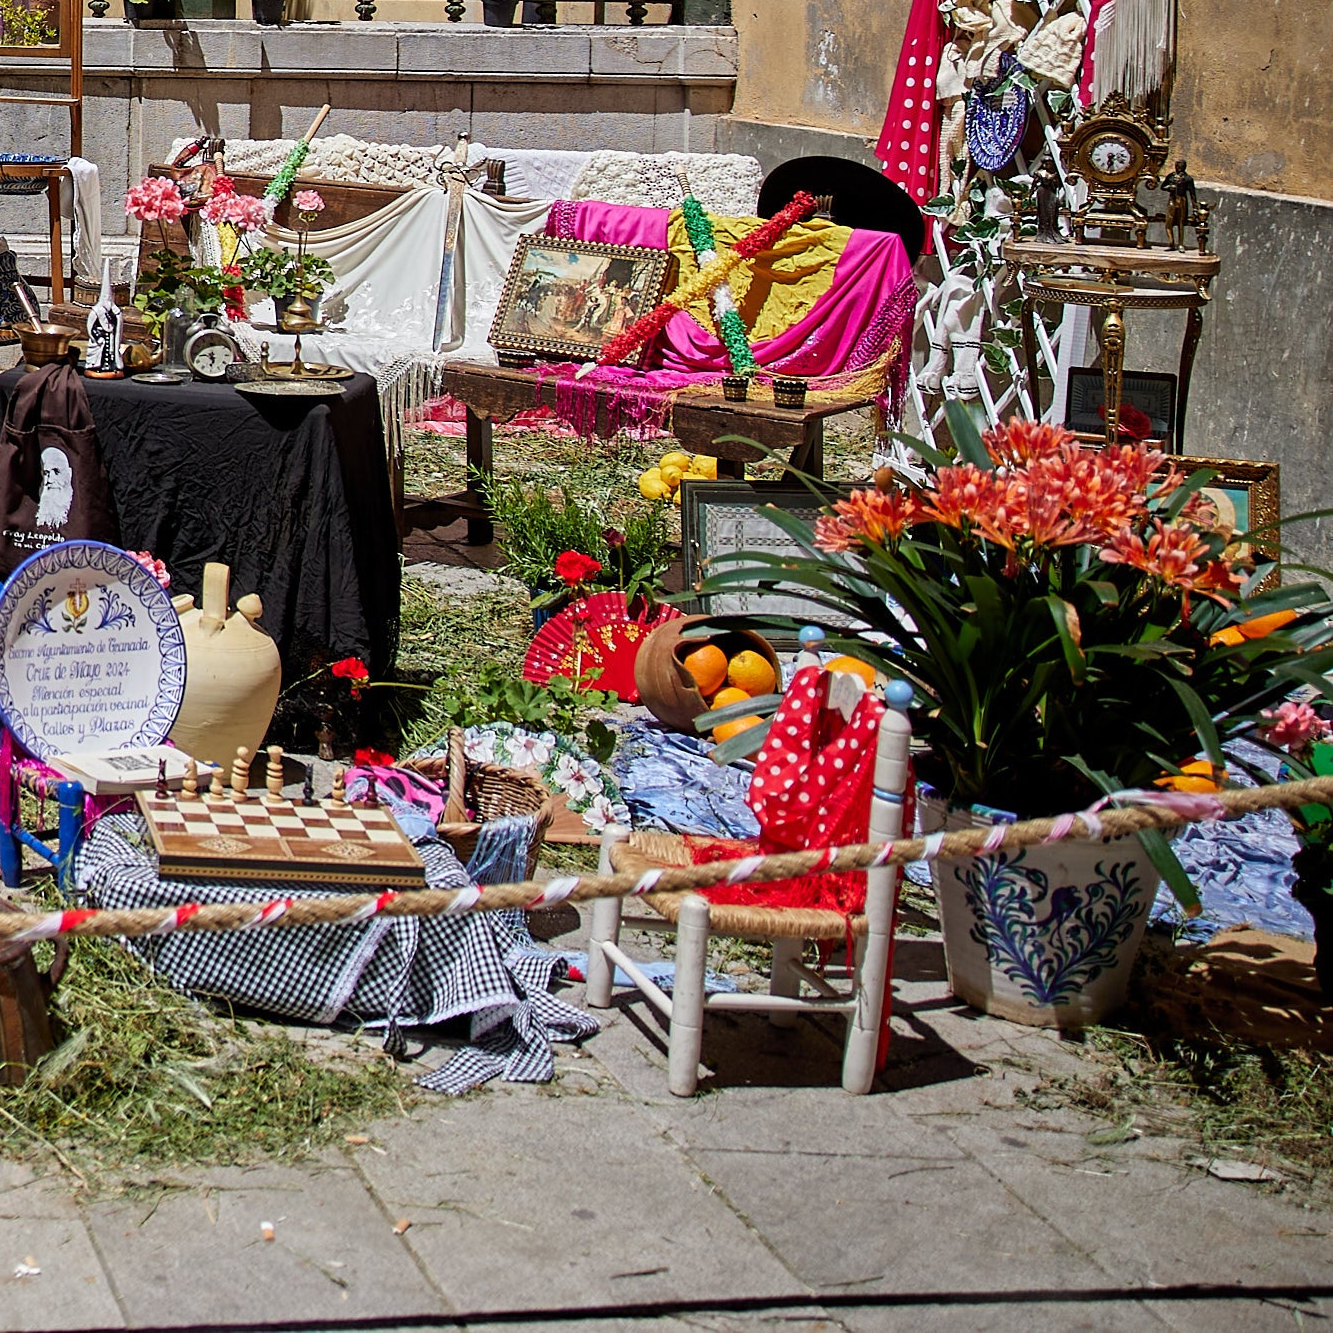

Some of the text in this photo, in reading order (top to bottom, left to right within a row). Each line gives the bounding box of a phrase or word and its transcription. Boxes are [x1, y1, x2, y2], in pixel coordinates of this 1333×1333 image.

[2, 529, 65, 544] Fray Leopoldo
[37, 641, 94, 663] Ayuntamiento
[96, 639, 106, 653] de
[108, 637, 150, 654] Granada
[26, 660, 131, 686] Cruz de Mayo 2024
[32, 682, 124, 701] Mención especial
[23, 695, 150, 722] a la participación vecinal
[43, 722, 75, 736] Calles
[90, 715, 135, 734] Plazas
